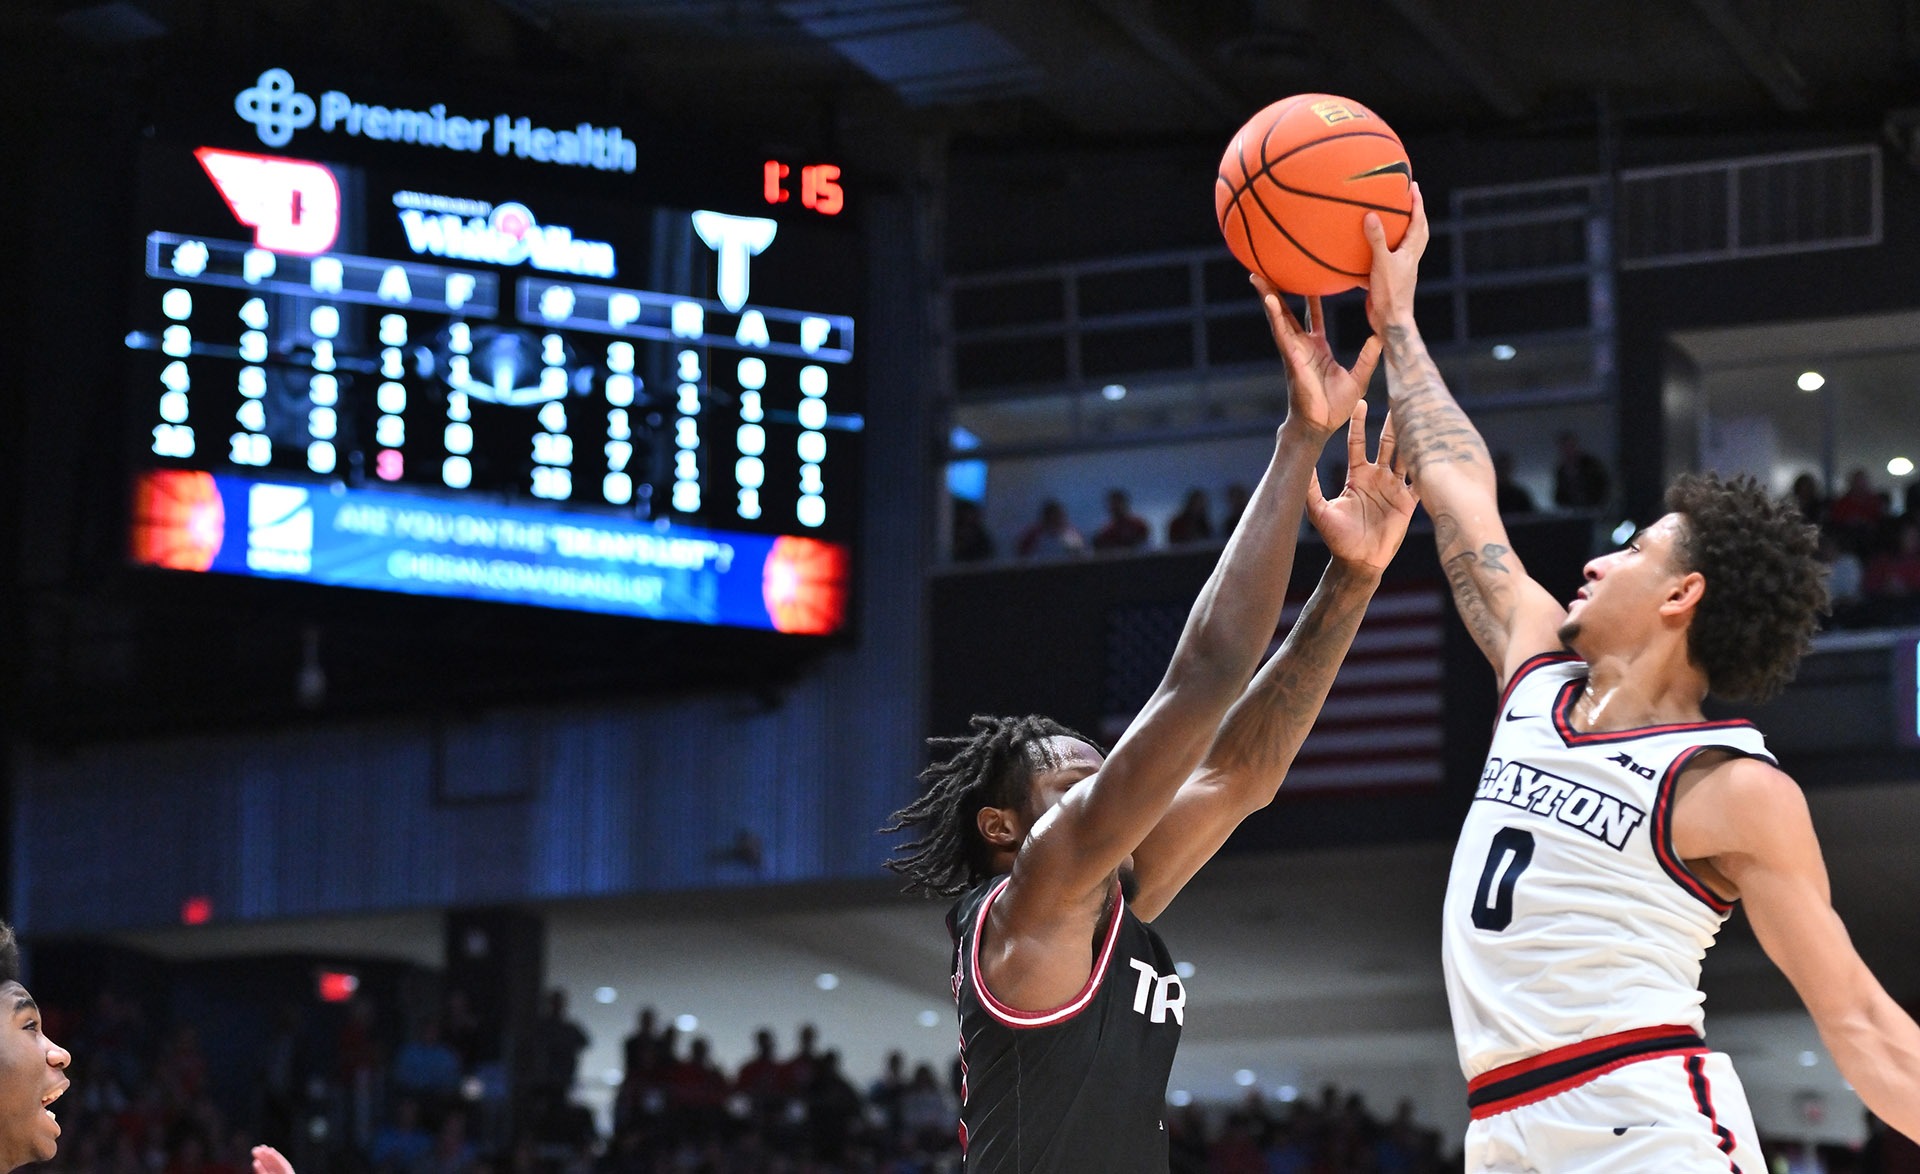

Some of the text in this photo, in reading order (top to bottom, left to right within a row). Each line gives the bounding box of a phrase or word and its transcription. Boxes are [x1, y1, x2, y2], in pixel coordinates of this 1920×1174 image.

[320, 90, 637, 174] Premier Health
[243, 249, 276, 284] P
[377, 265, 412, 302] A
[445, 273, 476, 308] F
[608, 292, 641, 330] P
[735, 310, 770, 348] A
[801, 317, 831, 353] F
[1605, 751, 1656, 780] A10
[1475, 757, 1646, 851] DAYTON
[1471, 826, 1535, 932] 0
